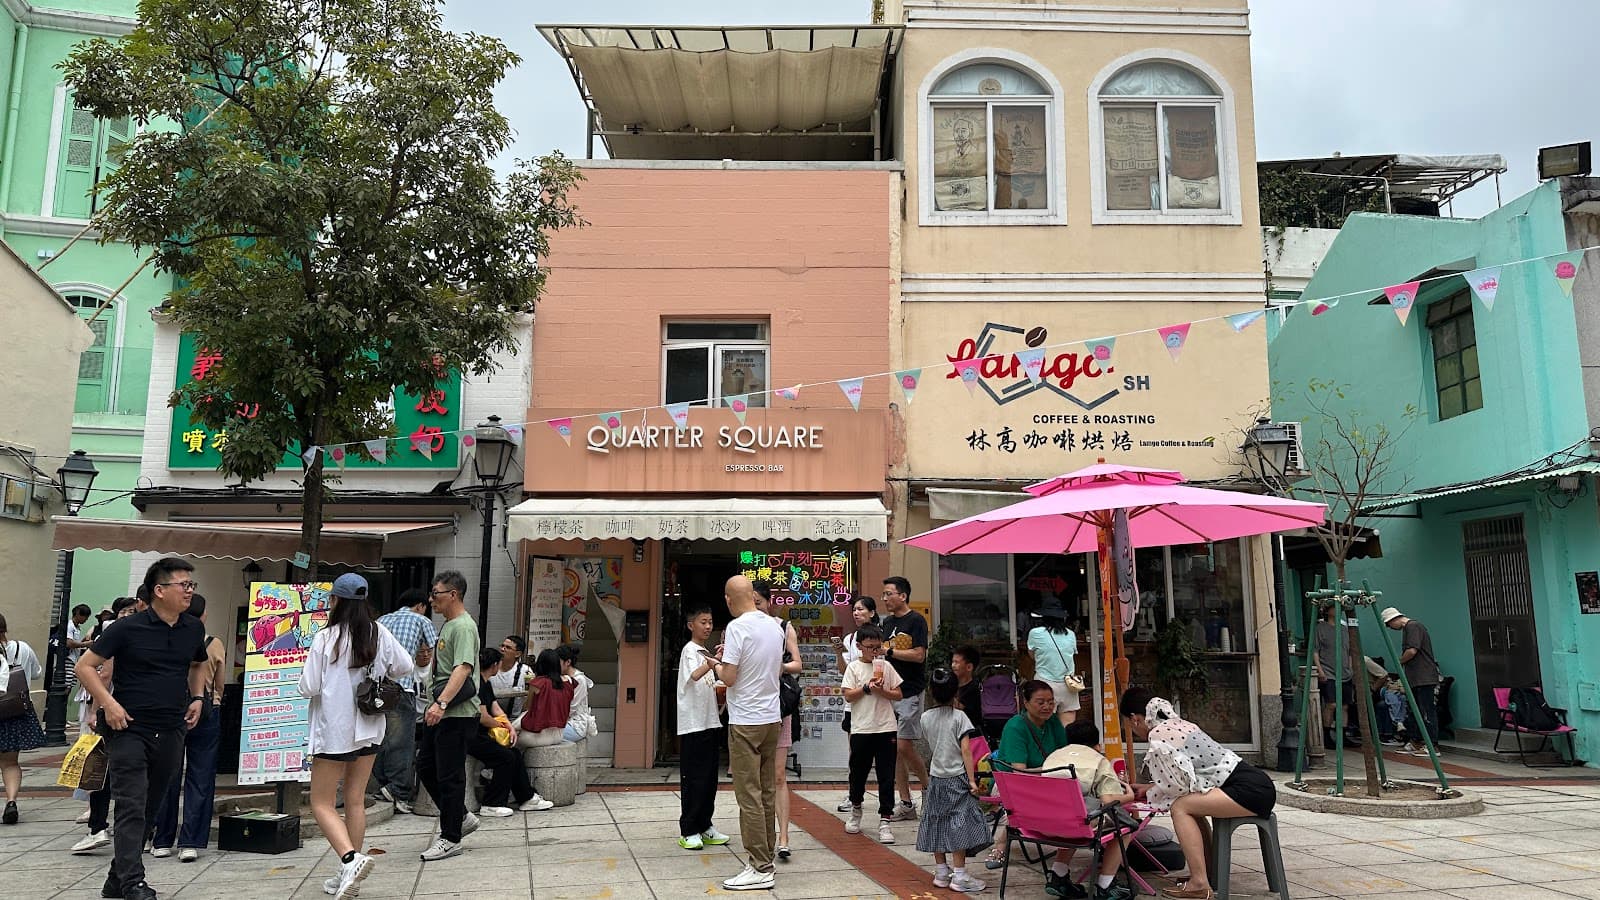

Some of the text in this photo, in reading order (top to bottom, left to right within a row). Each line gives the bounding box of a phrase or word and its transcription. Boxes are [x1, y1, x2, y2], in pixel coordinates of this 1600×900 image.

[1123, 375, 1150, 391] SH
[1033, 415, 1155, 424] COFFEE & ROASTING
[586, 425, 823, 454] QUARTER SQUARE
[966, 426, 1134, 454] 林高咖啡烘焙
[725, 464, 784, 472] ESPRESSO BAR
[536, 519, 861, 535] 檸檬茶 咖啡 奶茶 冰沙 啤酒 紀念品
[802, 581, 831, 589] OPEN
